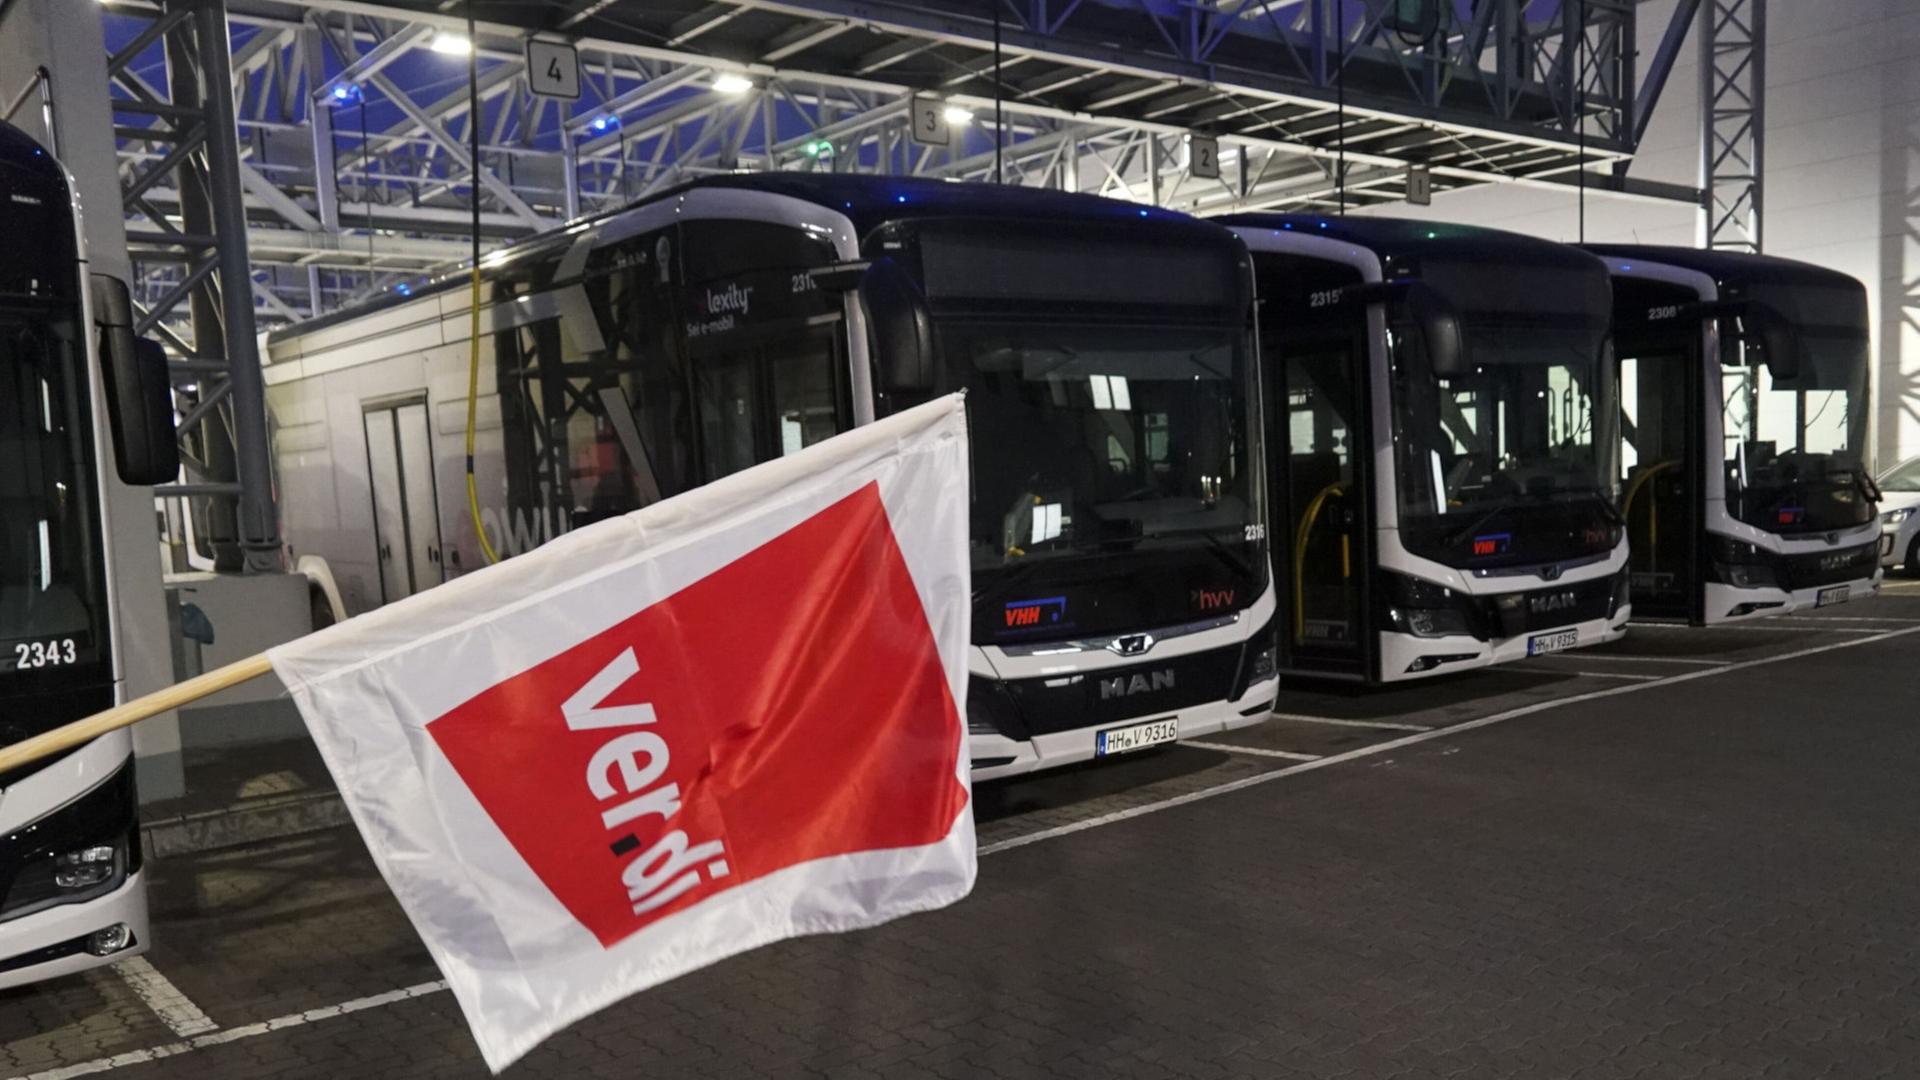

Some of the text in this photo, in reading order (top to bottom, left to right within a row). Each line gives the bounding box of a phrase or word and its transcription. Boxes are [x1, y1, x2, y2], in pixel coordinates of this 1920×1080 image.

[547, 57, 562, 82] 4
[926, 110, 936, 132] 3
[1201, 148, 1210, 168] 2
[697, 282, 749, 315] lexity
[1310, 289, 1340, 307] 2315
[1245, 524, 1265, 540] 2316
[1200, 590, 1234, 609] hvv
[1531, 592, 1576, 613] MAN
[1006, 606, 1040, 626] VHH
[15, 638, 76, 669] 2343
[1101, 669, 1175, 699] MAN
[1107, 722, 1176, 750] HH V 9316
[560, 645, 730, 916] ver.di
